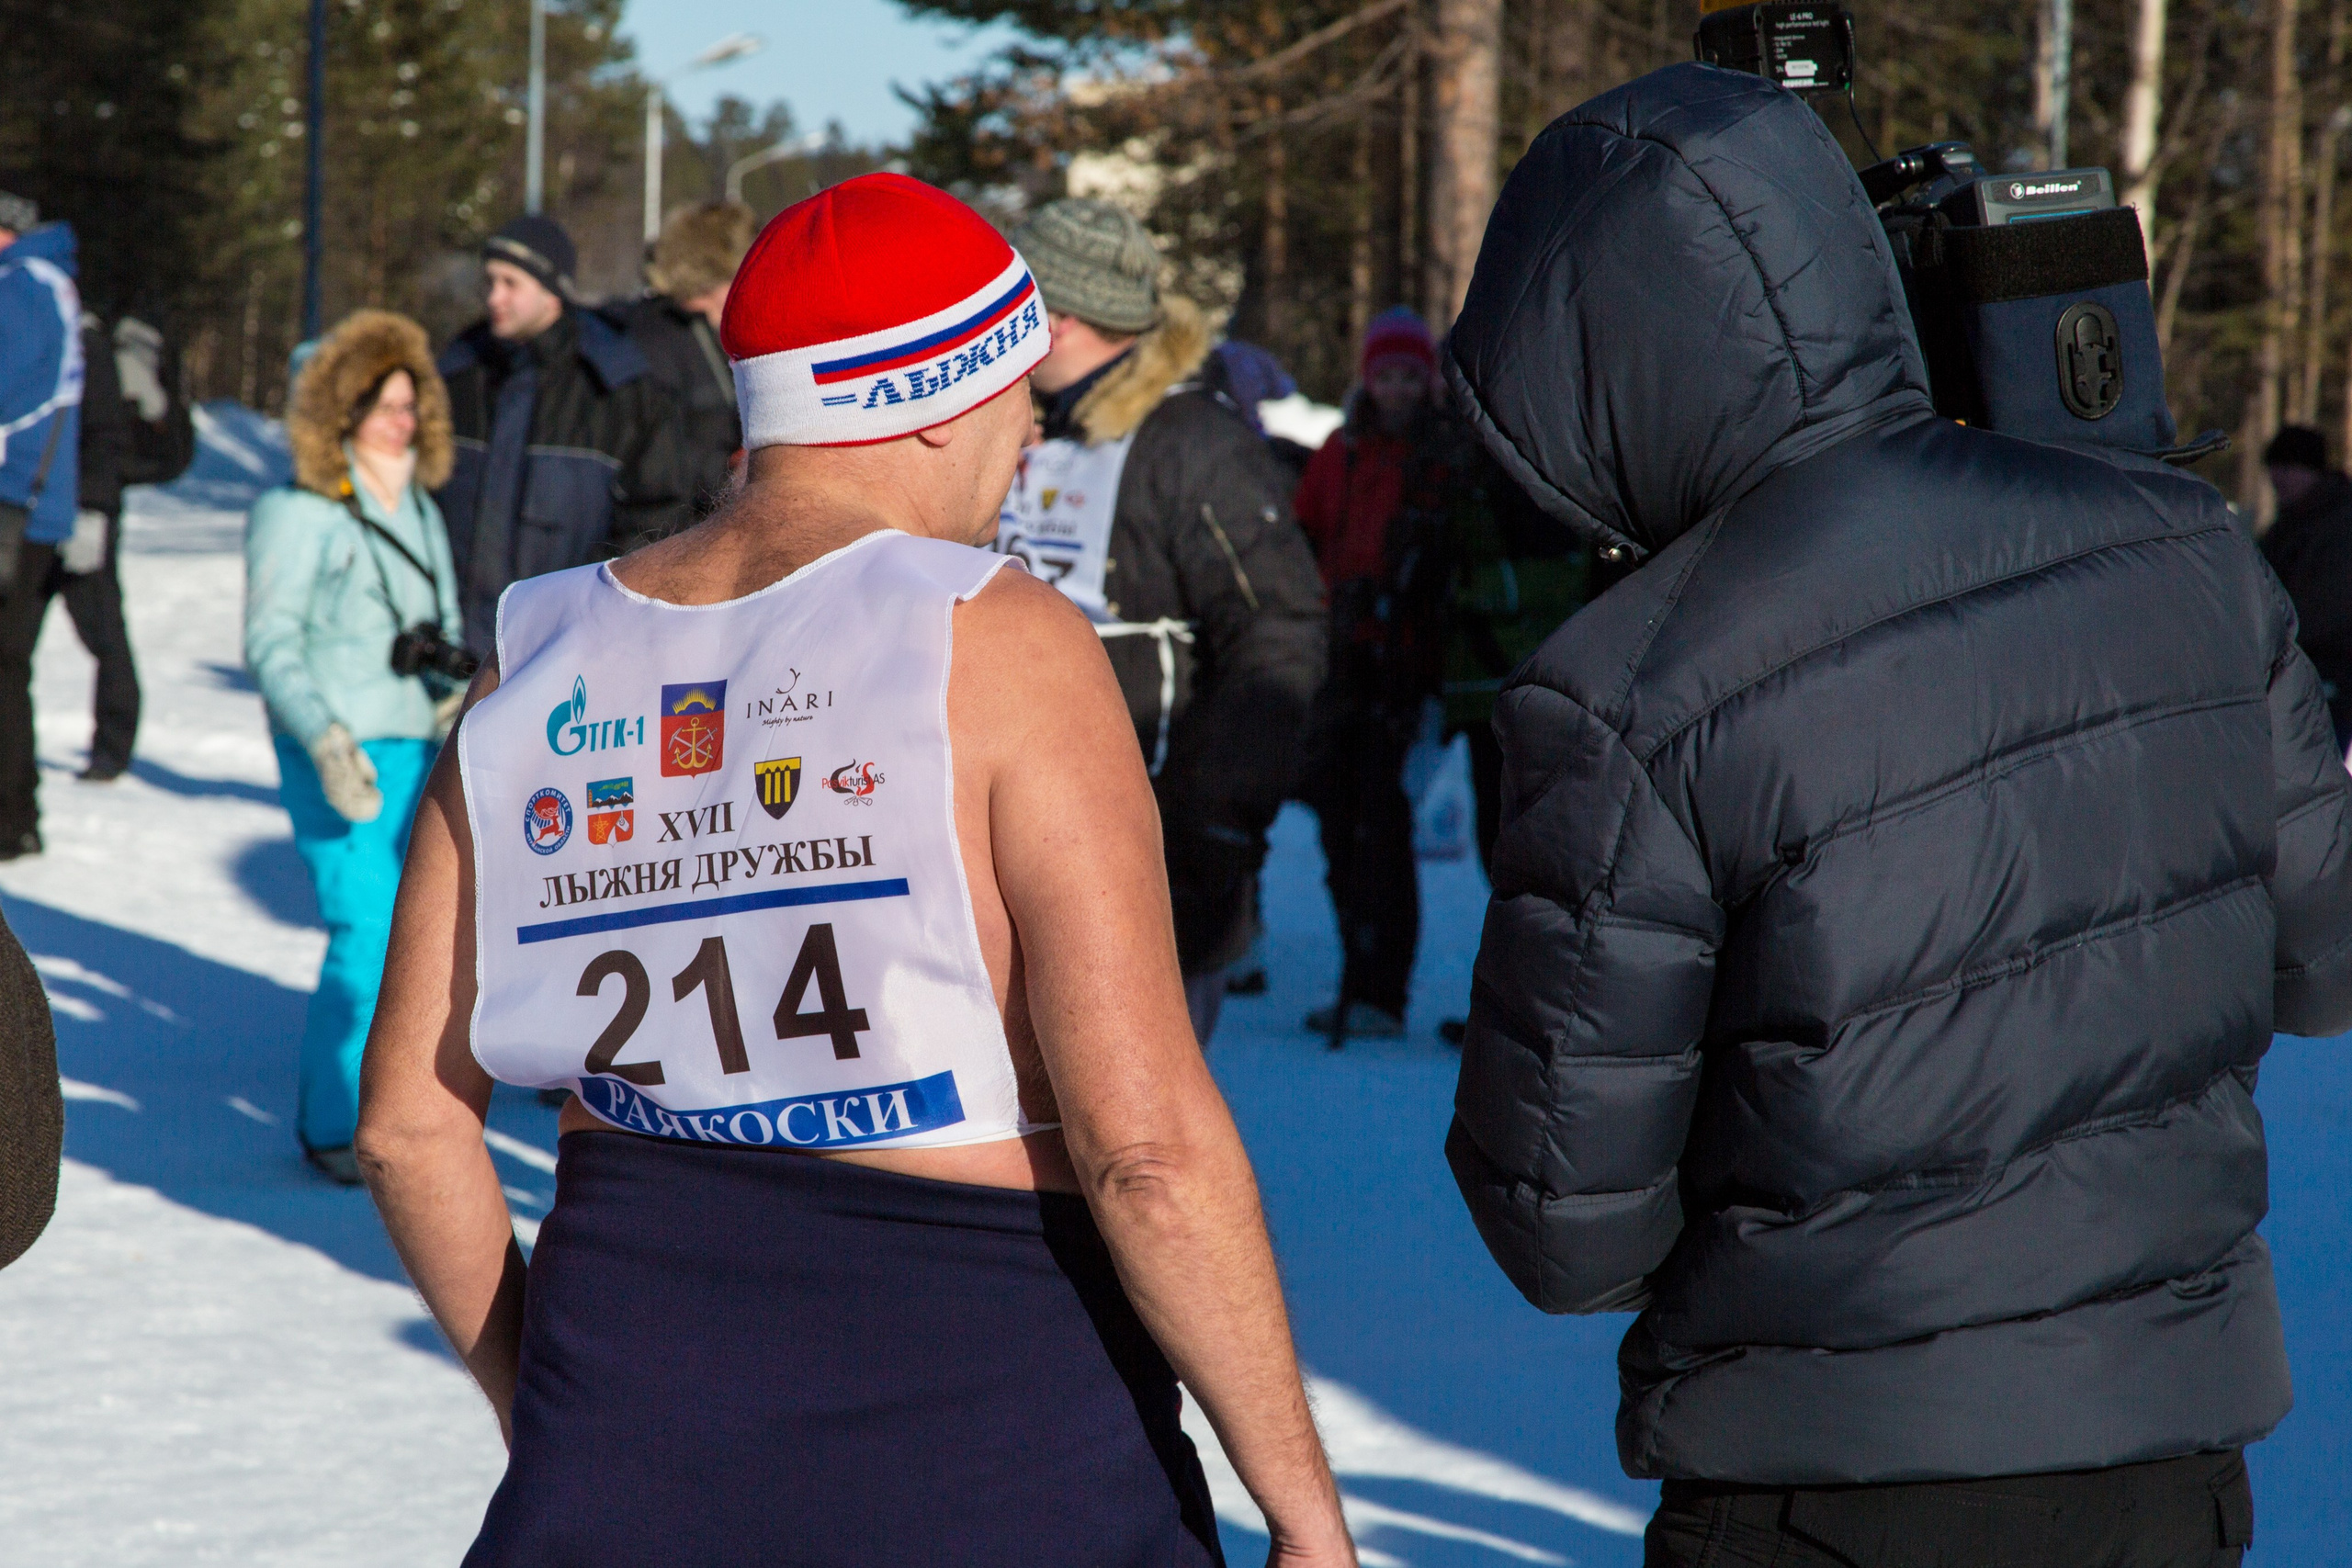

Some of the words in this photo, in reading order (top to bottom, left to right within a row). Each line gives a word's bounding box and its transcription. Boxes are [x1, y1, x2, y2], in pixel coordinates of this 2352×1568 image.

[2026, 184, 2078, 195] Beillen
[863, 299, 1040, 409] ЛЫЖНЯ
[746, 691, 832, 718] INARI
[762, 716, 783, 728] Mighty
[785, 716, 792, 727] by
[793, 715, 814, 724] nature
[873, 773, 886, 784] AS
[525, 789, 571, 822] СПОРТКОМИТЕТ
[656, 801, 736, 843] XVII
[554, 825, 571, 851] ОБЛАСТИ
[538, 857, 684, 909] ЛЫЖНЯ
[691, 835, 876, 896] ДРУЖБЫ
[575, 922, 871, 1086] 214
[605, 1079, 919, 1145] РАЯКОСКИ
